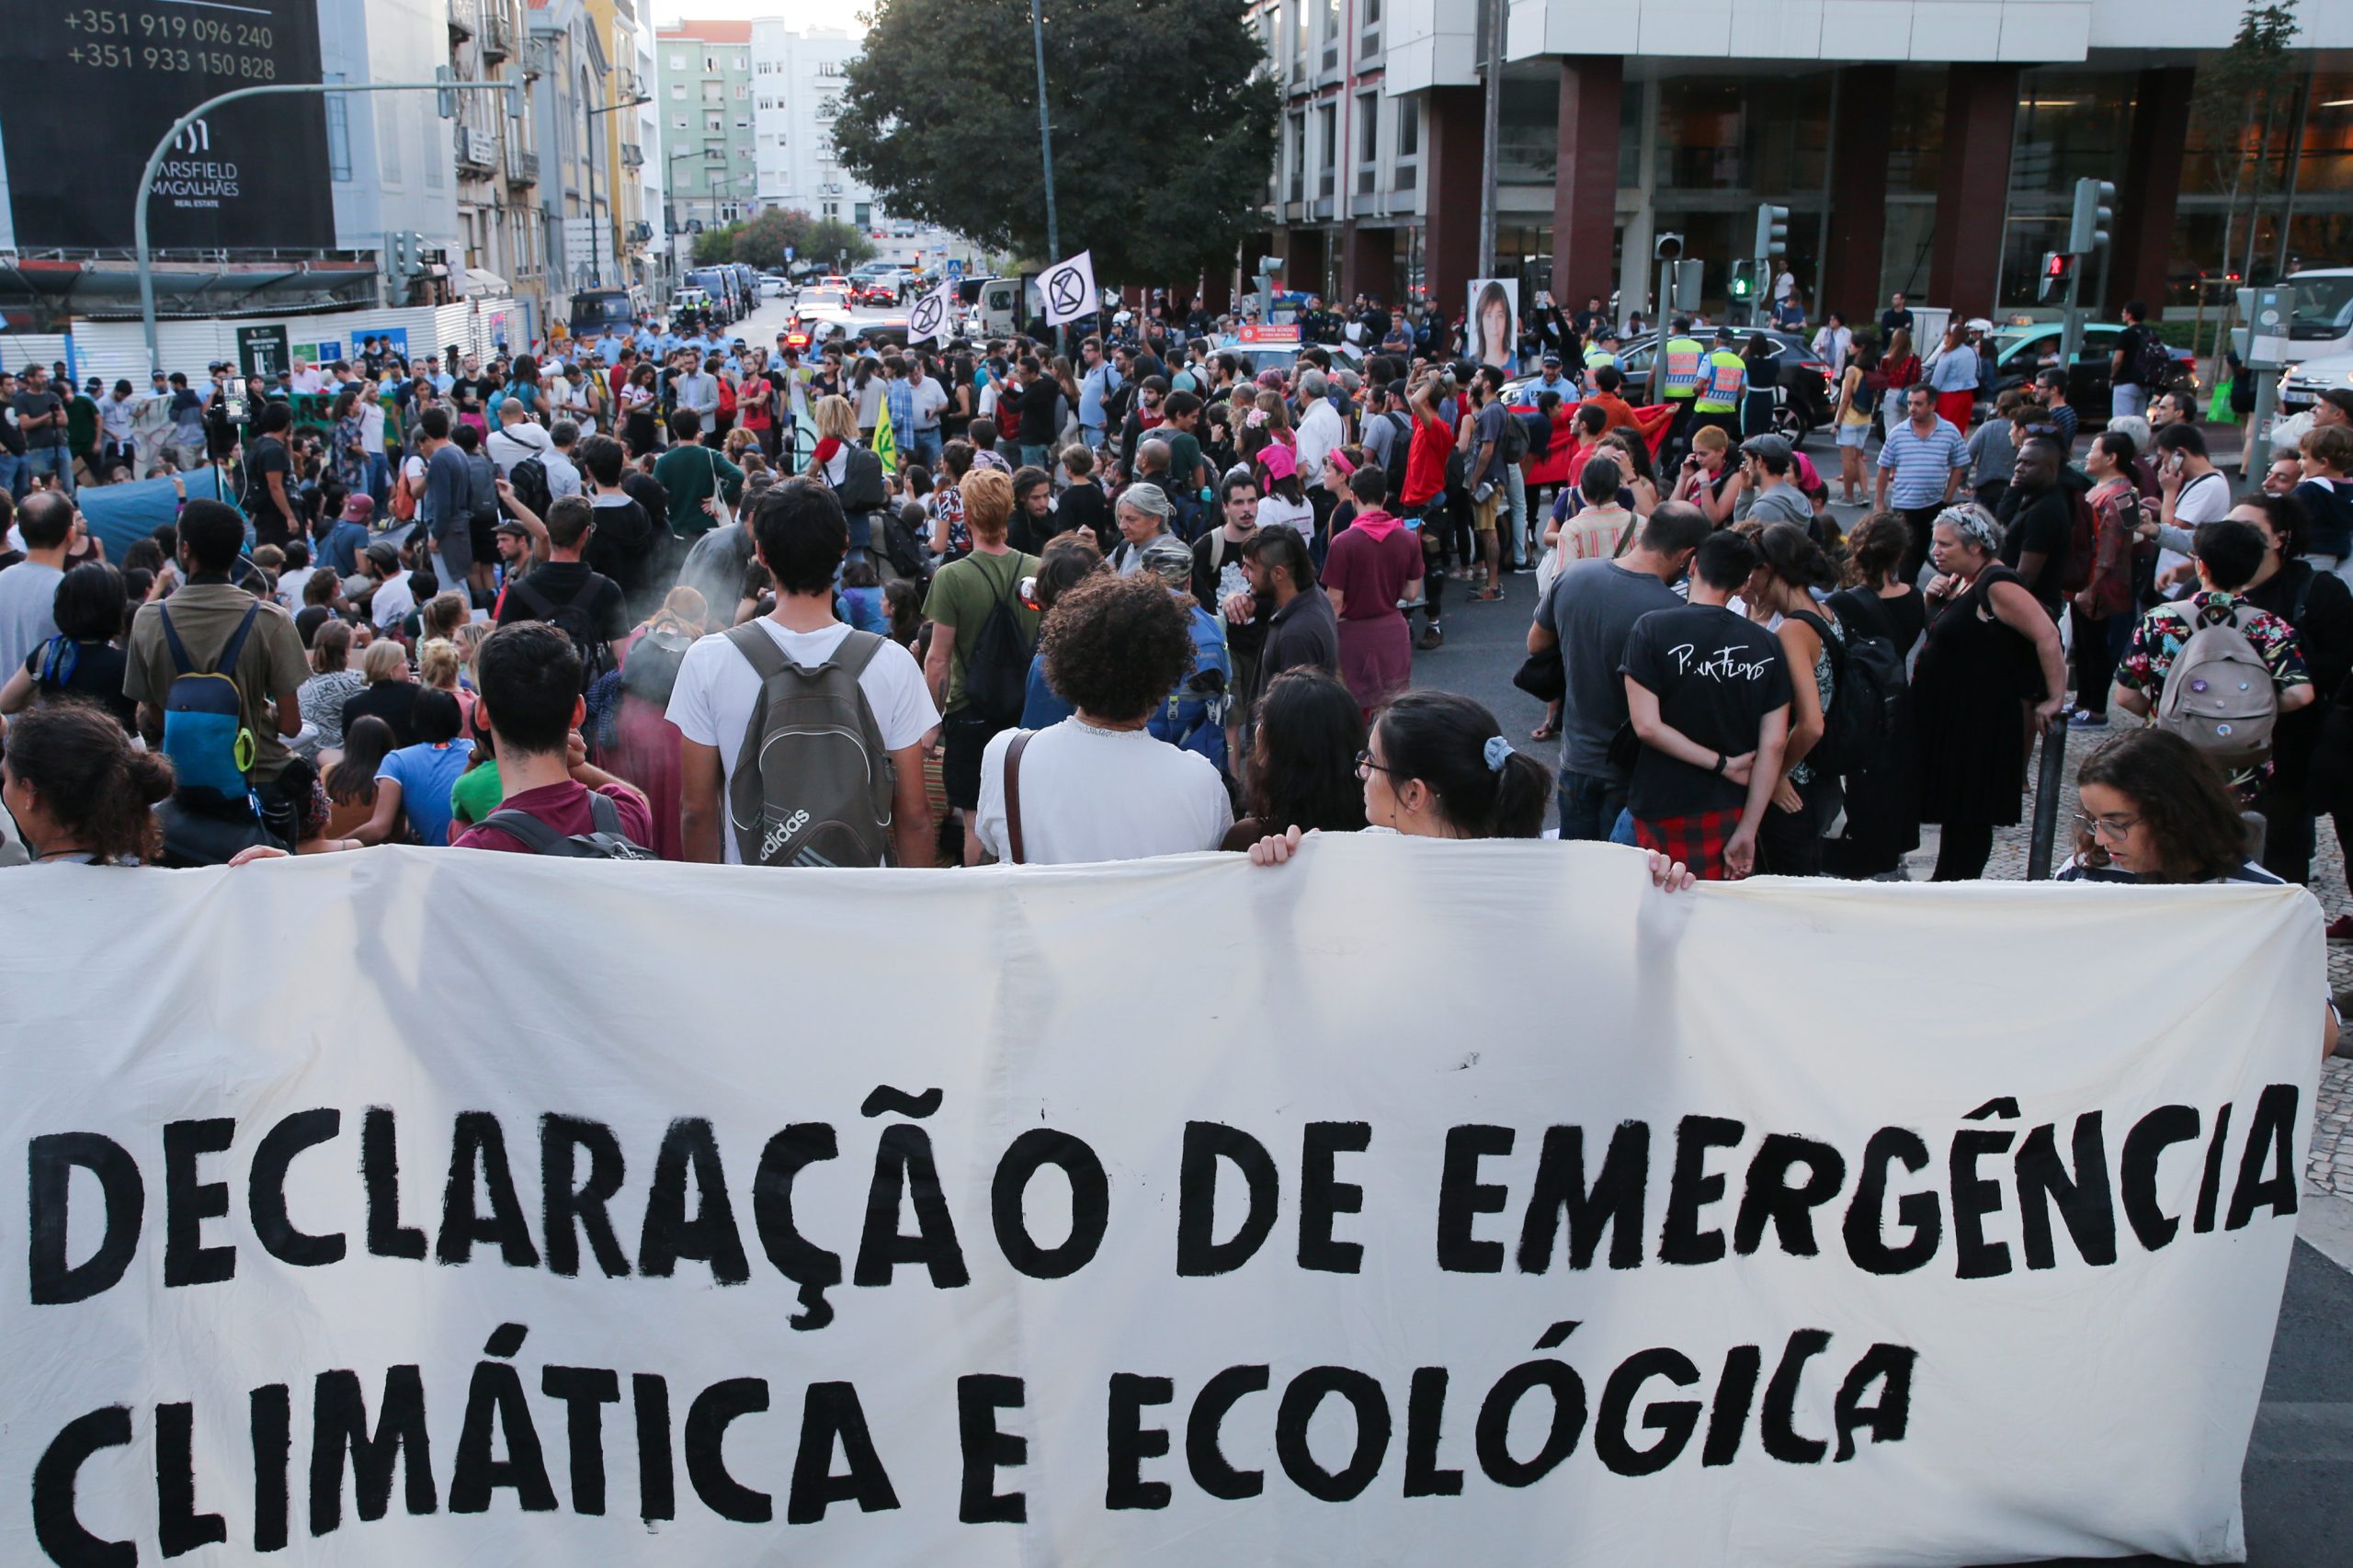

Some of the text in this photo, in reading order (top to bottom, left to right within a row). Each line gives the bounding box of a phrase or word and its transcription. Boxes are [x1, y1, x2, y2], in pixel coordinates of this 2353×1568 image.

[64, 8, 273, 49] +351 919 096 240
[68, 43, 276, 80] +351 933 150 828
[146, 161, 238, 179] ARSFIELD
[174, 199, 219, 209] REAL ESTATE
[759, 809, 811, 861] adidas
[28, 1083, 2299, 1332] DECLARAÇÃO DE EMERGÊNCIA
[31, 1320, 1918, 1568] CLIMÁTICA E ECOLÓGICA
